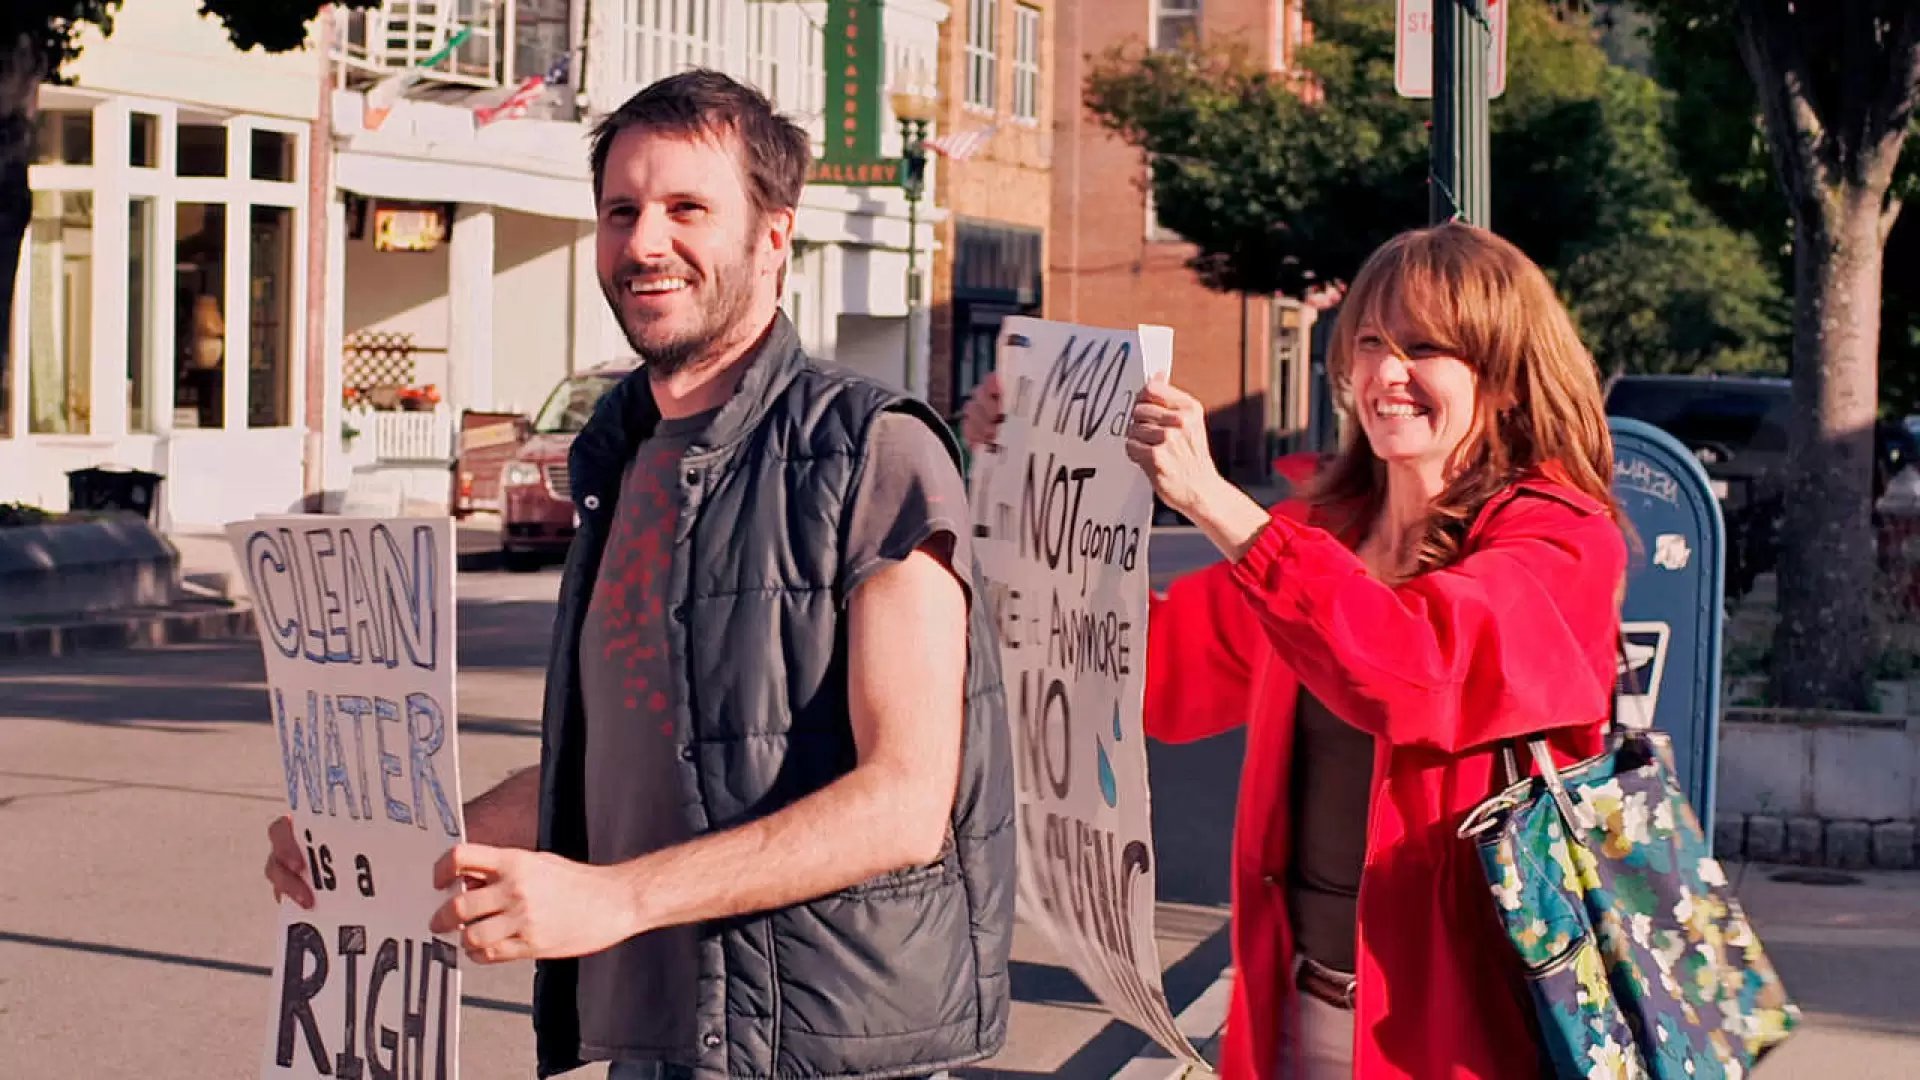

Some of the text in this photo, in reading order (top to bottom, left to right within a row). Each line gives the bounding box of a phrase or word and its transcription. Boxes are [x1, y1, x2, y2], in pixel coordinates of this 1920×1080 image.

[1032, 334, 1131, 442] MAD
[246, 523, 437, 670] CLEAN
[1020, 452, 1097, 574] NOT
[1080, 518, 1140, 597] gonna
[274, 687, 461, 838] WATER
[1019, 668, 1071, 800] NO
[304, 828, 376, 897] is a
[276, 921, 458, 1080] RIGHT
